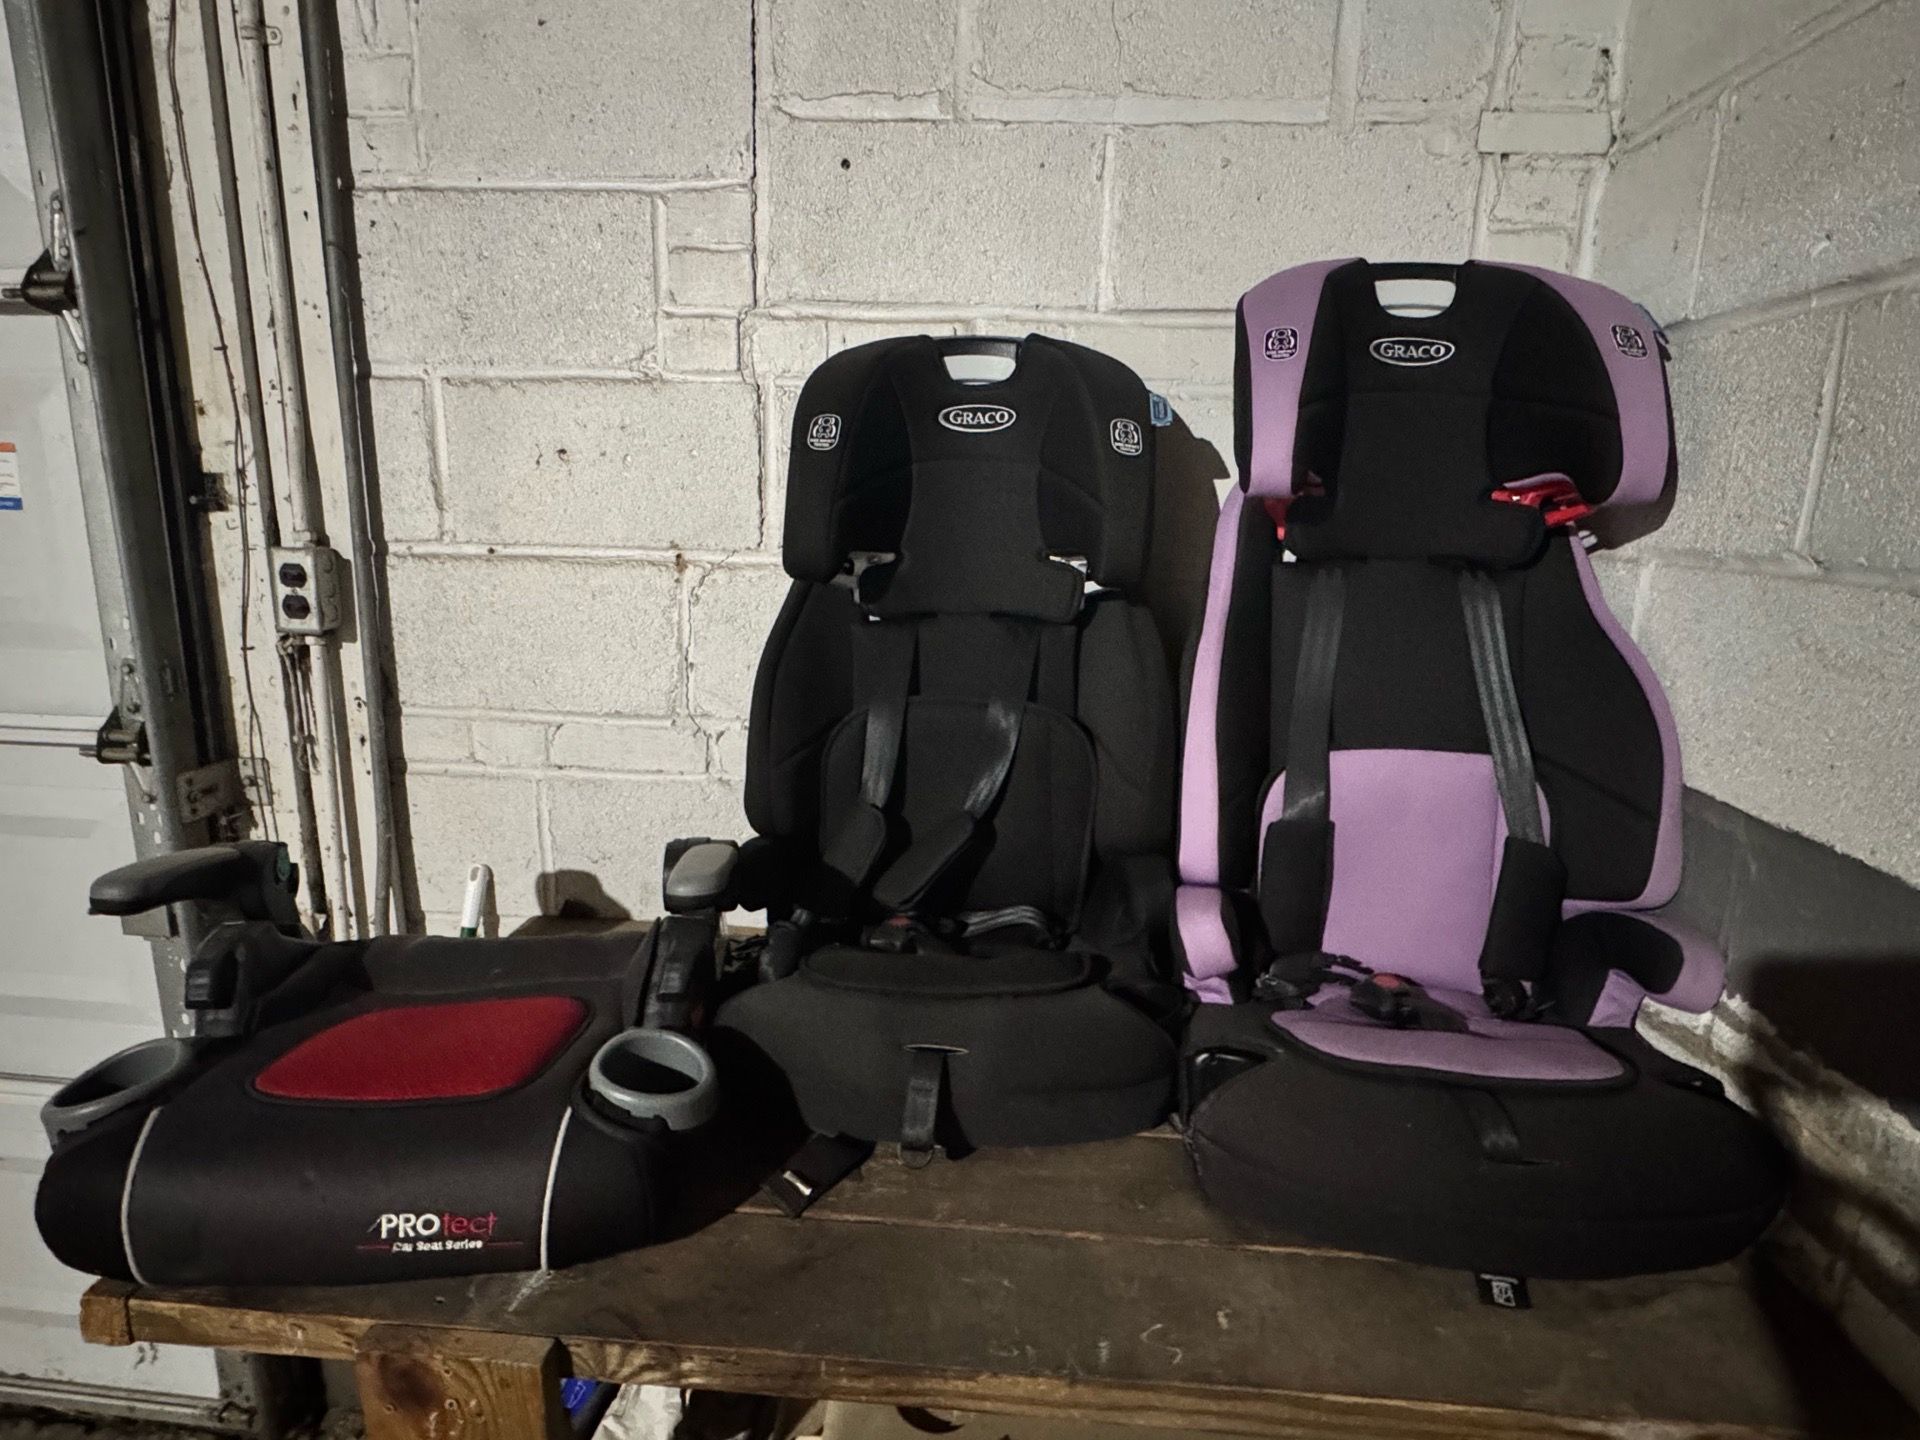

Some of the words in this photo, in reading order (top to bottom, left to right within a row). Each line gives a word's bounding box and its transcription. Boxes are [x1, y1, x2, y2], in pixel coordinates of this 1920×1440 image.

[1380, 342, 1446, 359] GRACO
[949, 409, 1009, 425] GRACO
[380, 1210, 498, 1240] PROtect
[392, 1241, 413, 1253] Car
[416, 1240, 444, 1252] Seat
[445, 1238, 484, 1251] Series
